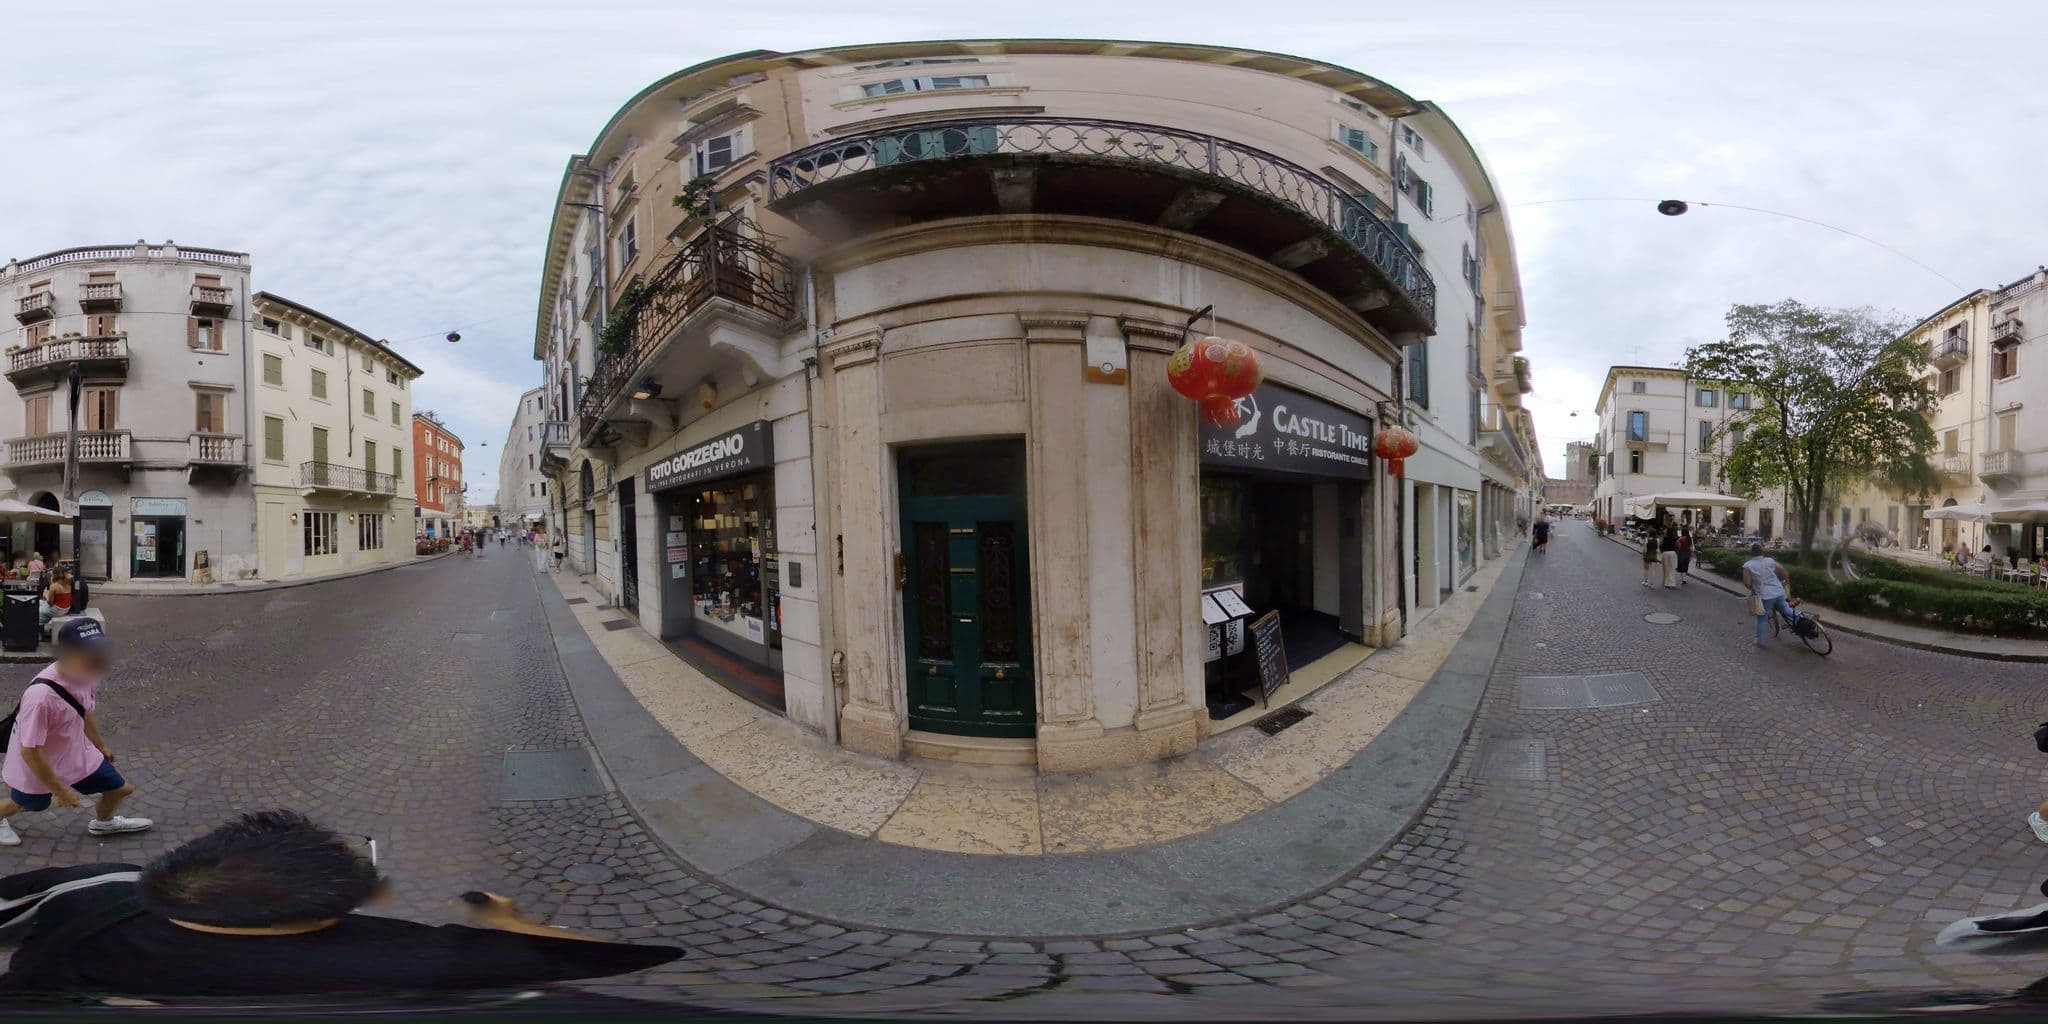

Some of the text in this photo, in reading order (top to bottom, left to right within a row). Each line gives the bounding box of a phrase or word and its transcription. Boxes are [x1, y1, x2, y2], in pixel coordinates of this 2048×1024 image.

[1272, 405, 1368, 452] CASTLE TIME
[651, 434, 743, 481] FOTO GORZEGNO
[1206, 439, 1265, 460] 城堡时光
[1273, 437, 1311, 457] 中餐厅
[1312, 448, 1350, 463] RISTORANTE
[669, 470, 701, 485] FOTOGRAFI
[715, 457, 750, 472] VERONA
